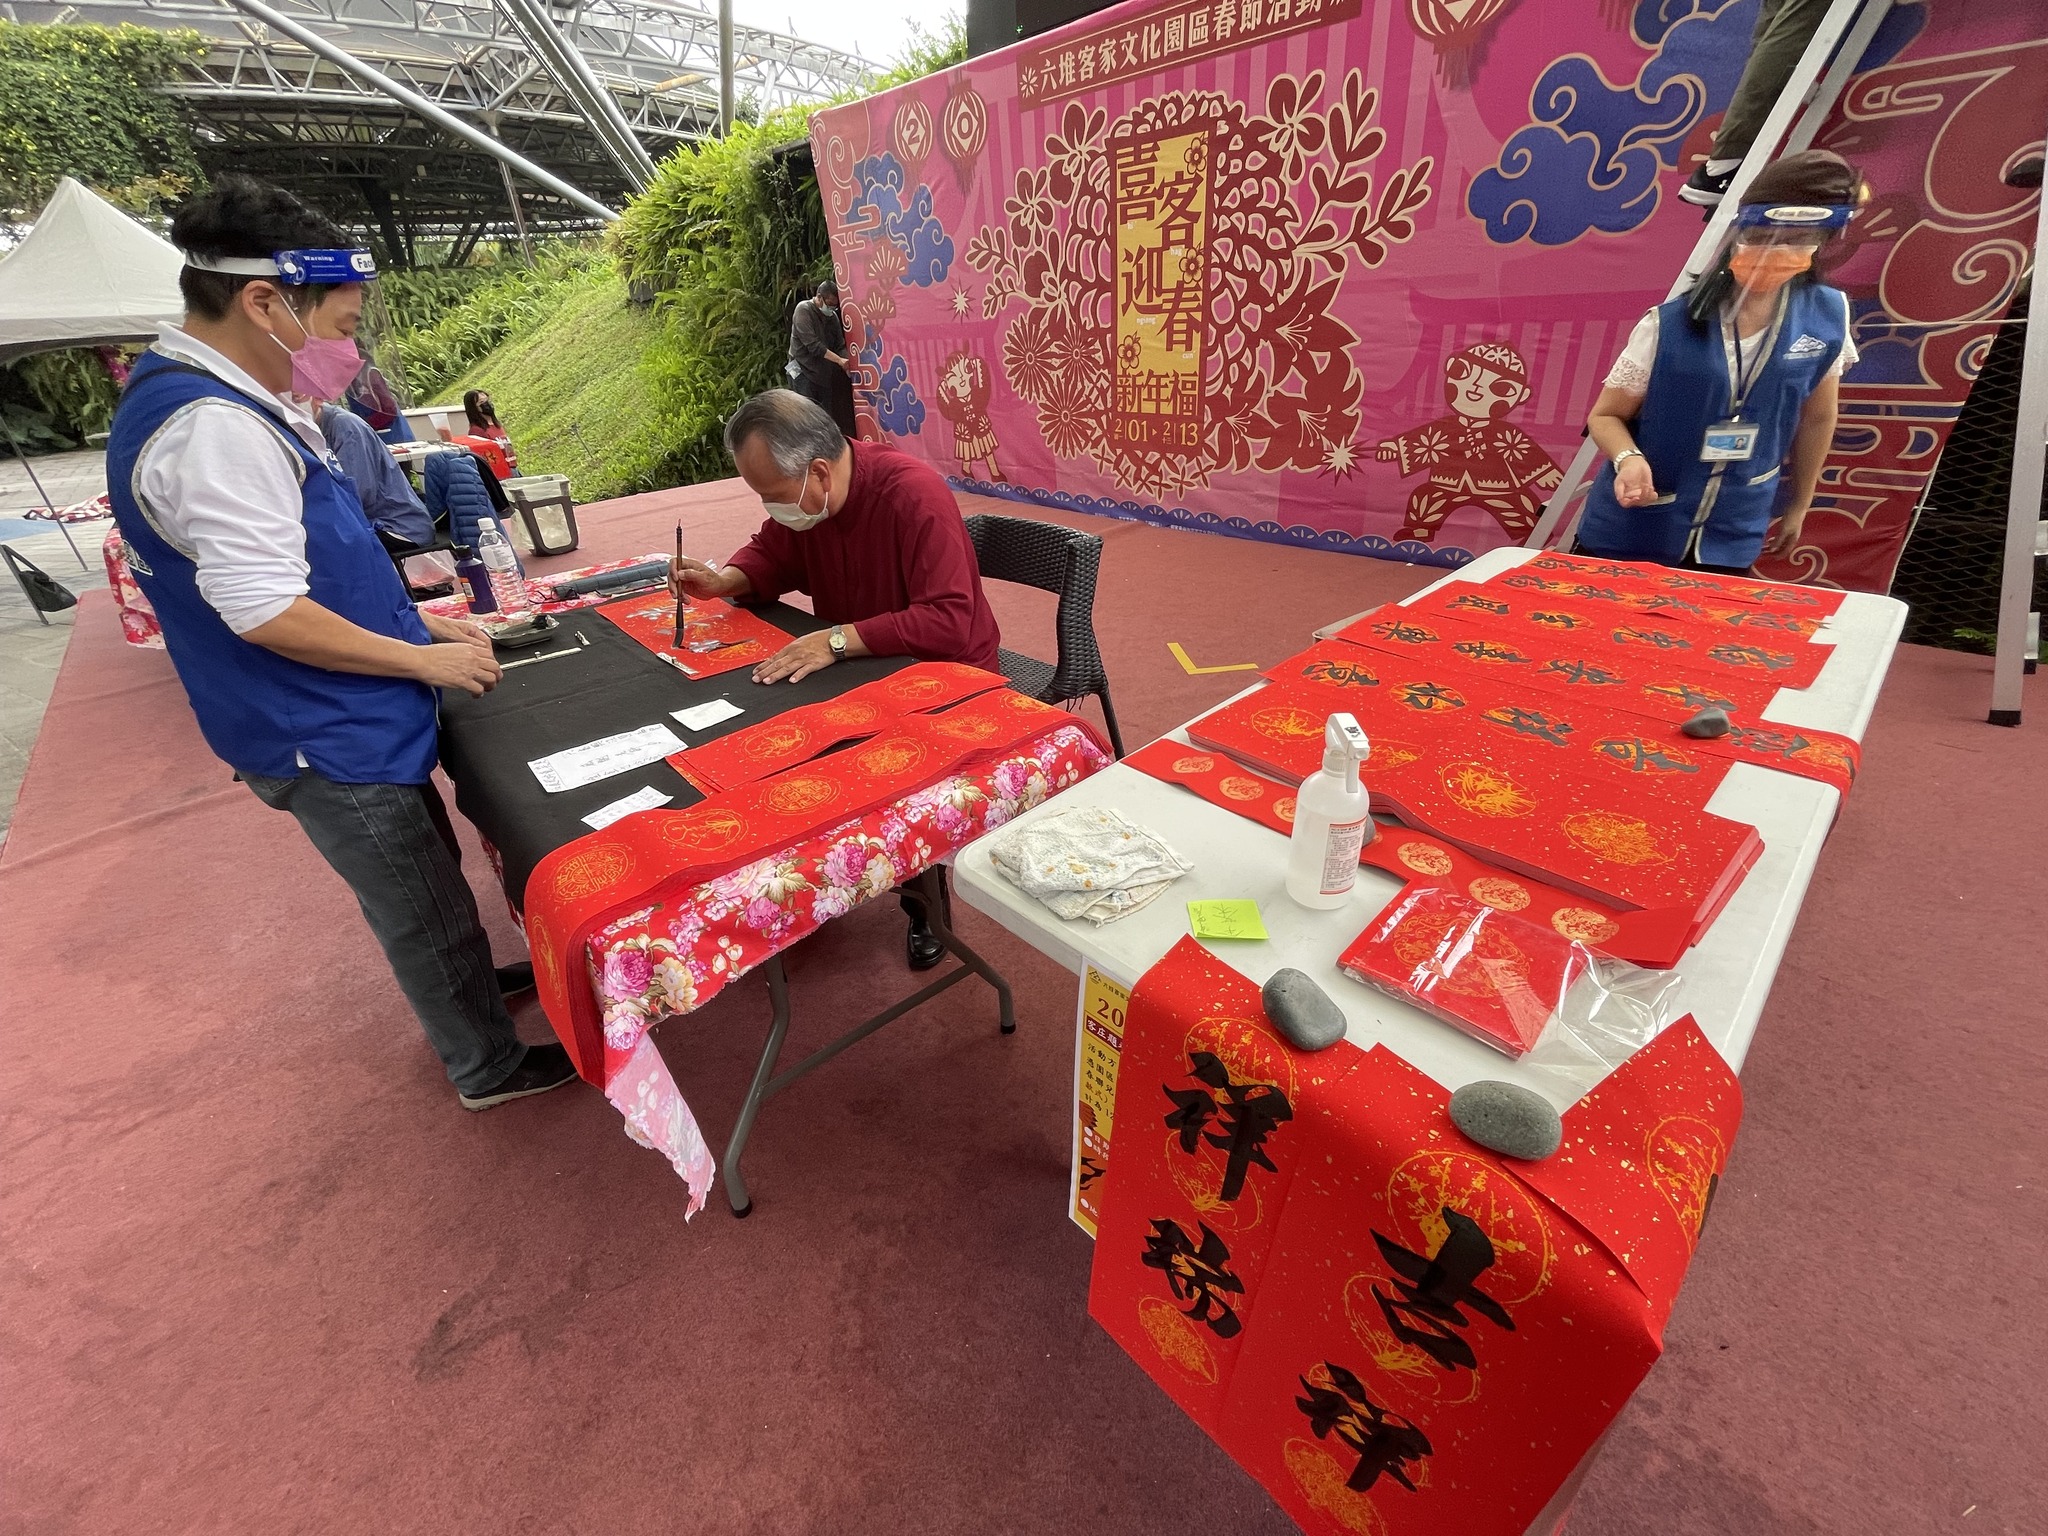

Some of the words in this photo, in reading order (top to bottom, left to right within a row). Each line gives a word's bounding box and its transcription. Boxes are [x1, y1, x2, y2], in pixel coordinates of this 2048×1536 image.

[1040, 0, 1345, 92] 六堆客家文化園區春節活
[905, 118, 920, 146] 2
[356, 257, 374, 269] Fac
[1116, 368, 1199, 417] 新年福
